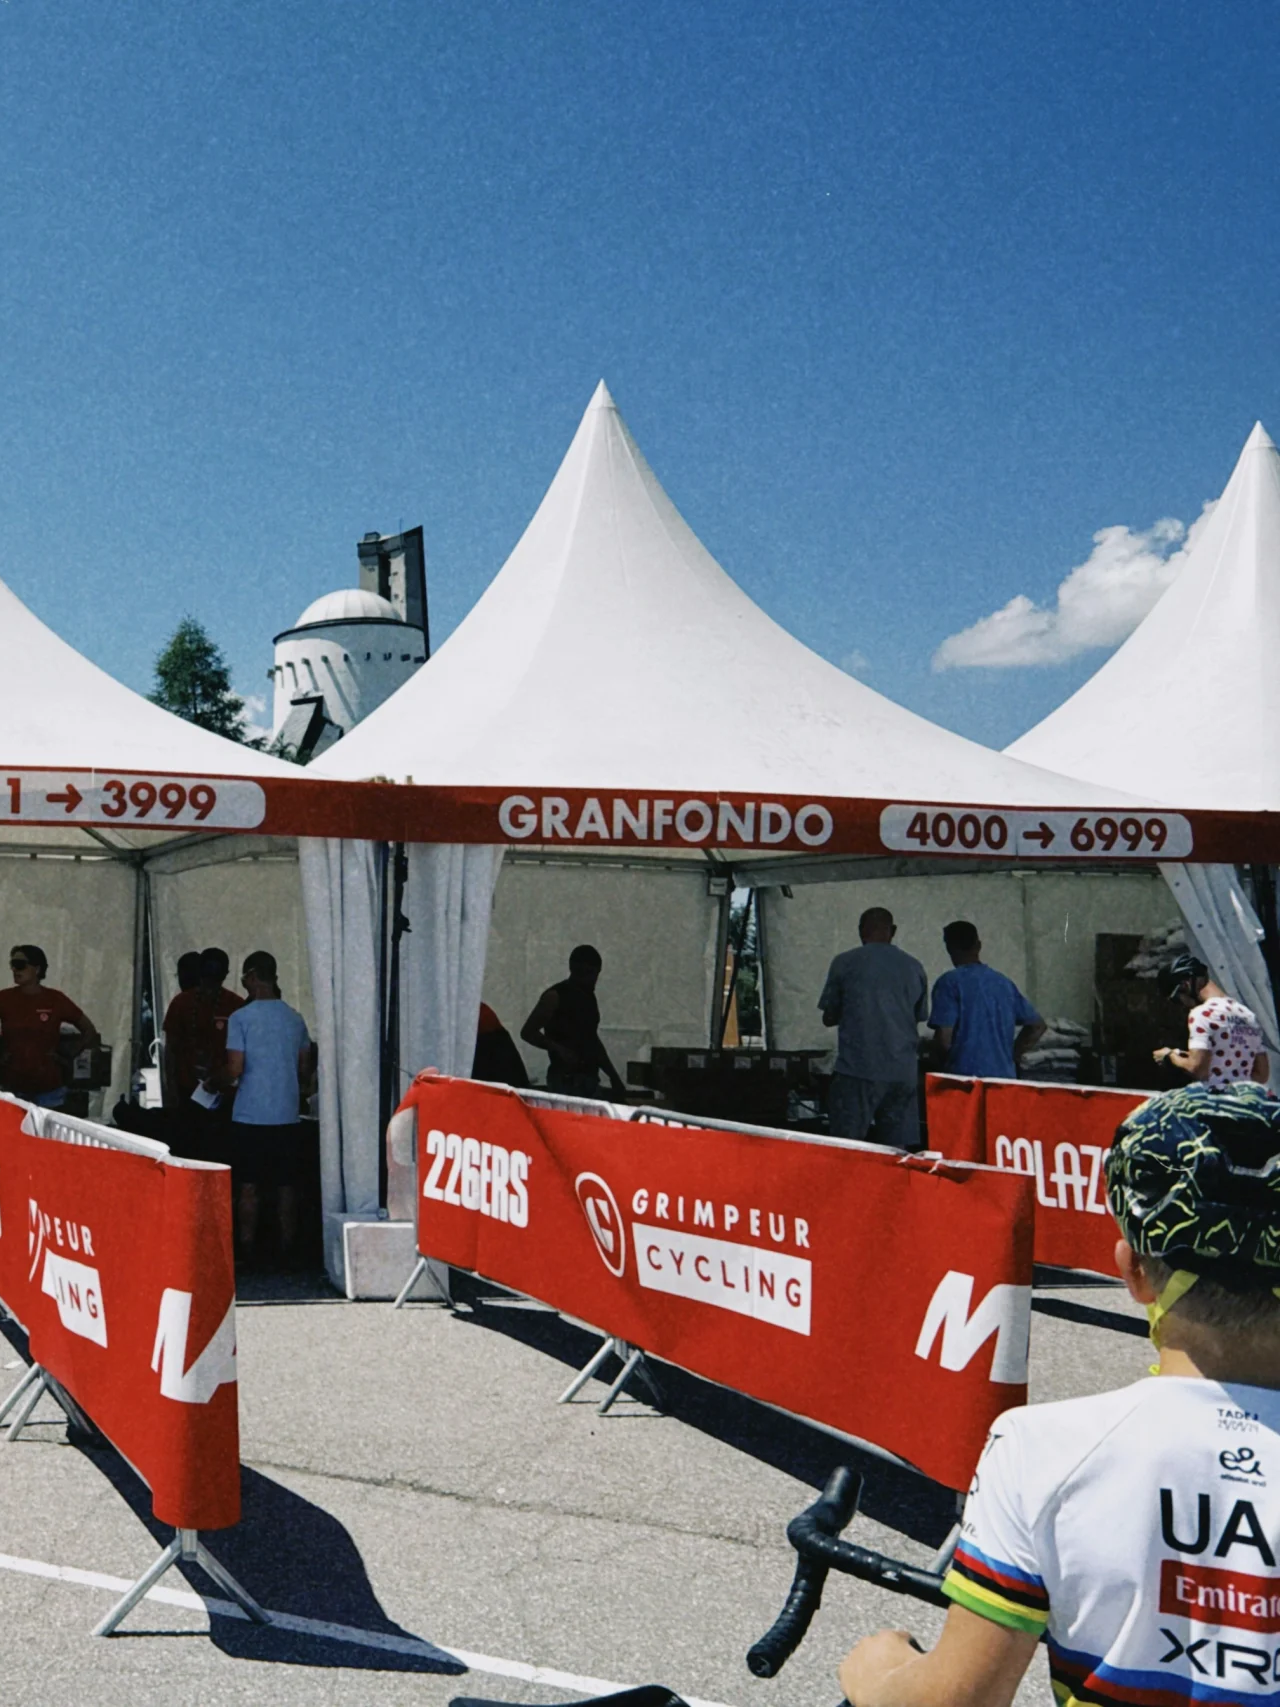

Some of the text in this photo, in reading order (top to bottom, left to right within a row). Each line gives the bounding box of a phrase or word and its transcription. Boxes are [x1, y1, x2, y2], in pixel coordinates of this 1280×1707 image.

[6, 777, 217, 820] 1 3999
[498, 794, 834, 847] GRANFONDO
[906, 812, 1168, 852] 4000 6999
[423, 1129, 529, 1228] 226ERS
[632, 1188, 811, 1249] GRIMPEUR
[646, 1244, 803, 1308] CYCLING
